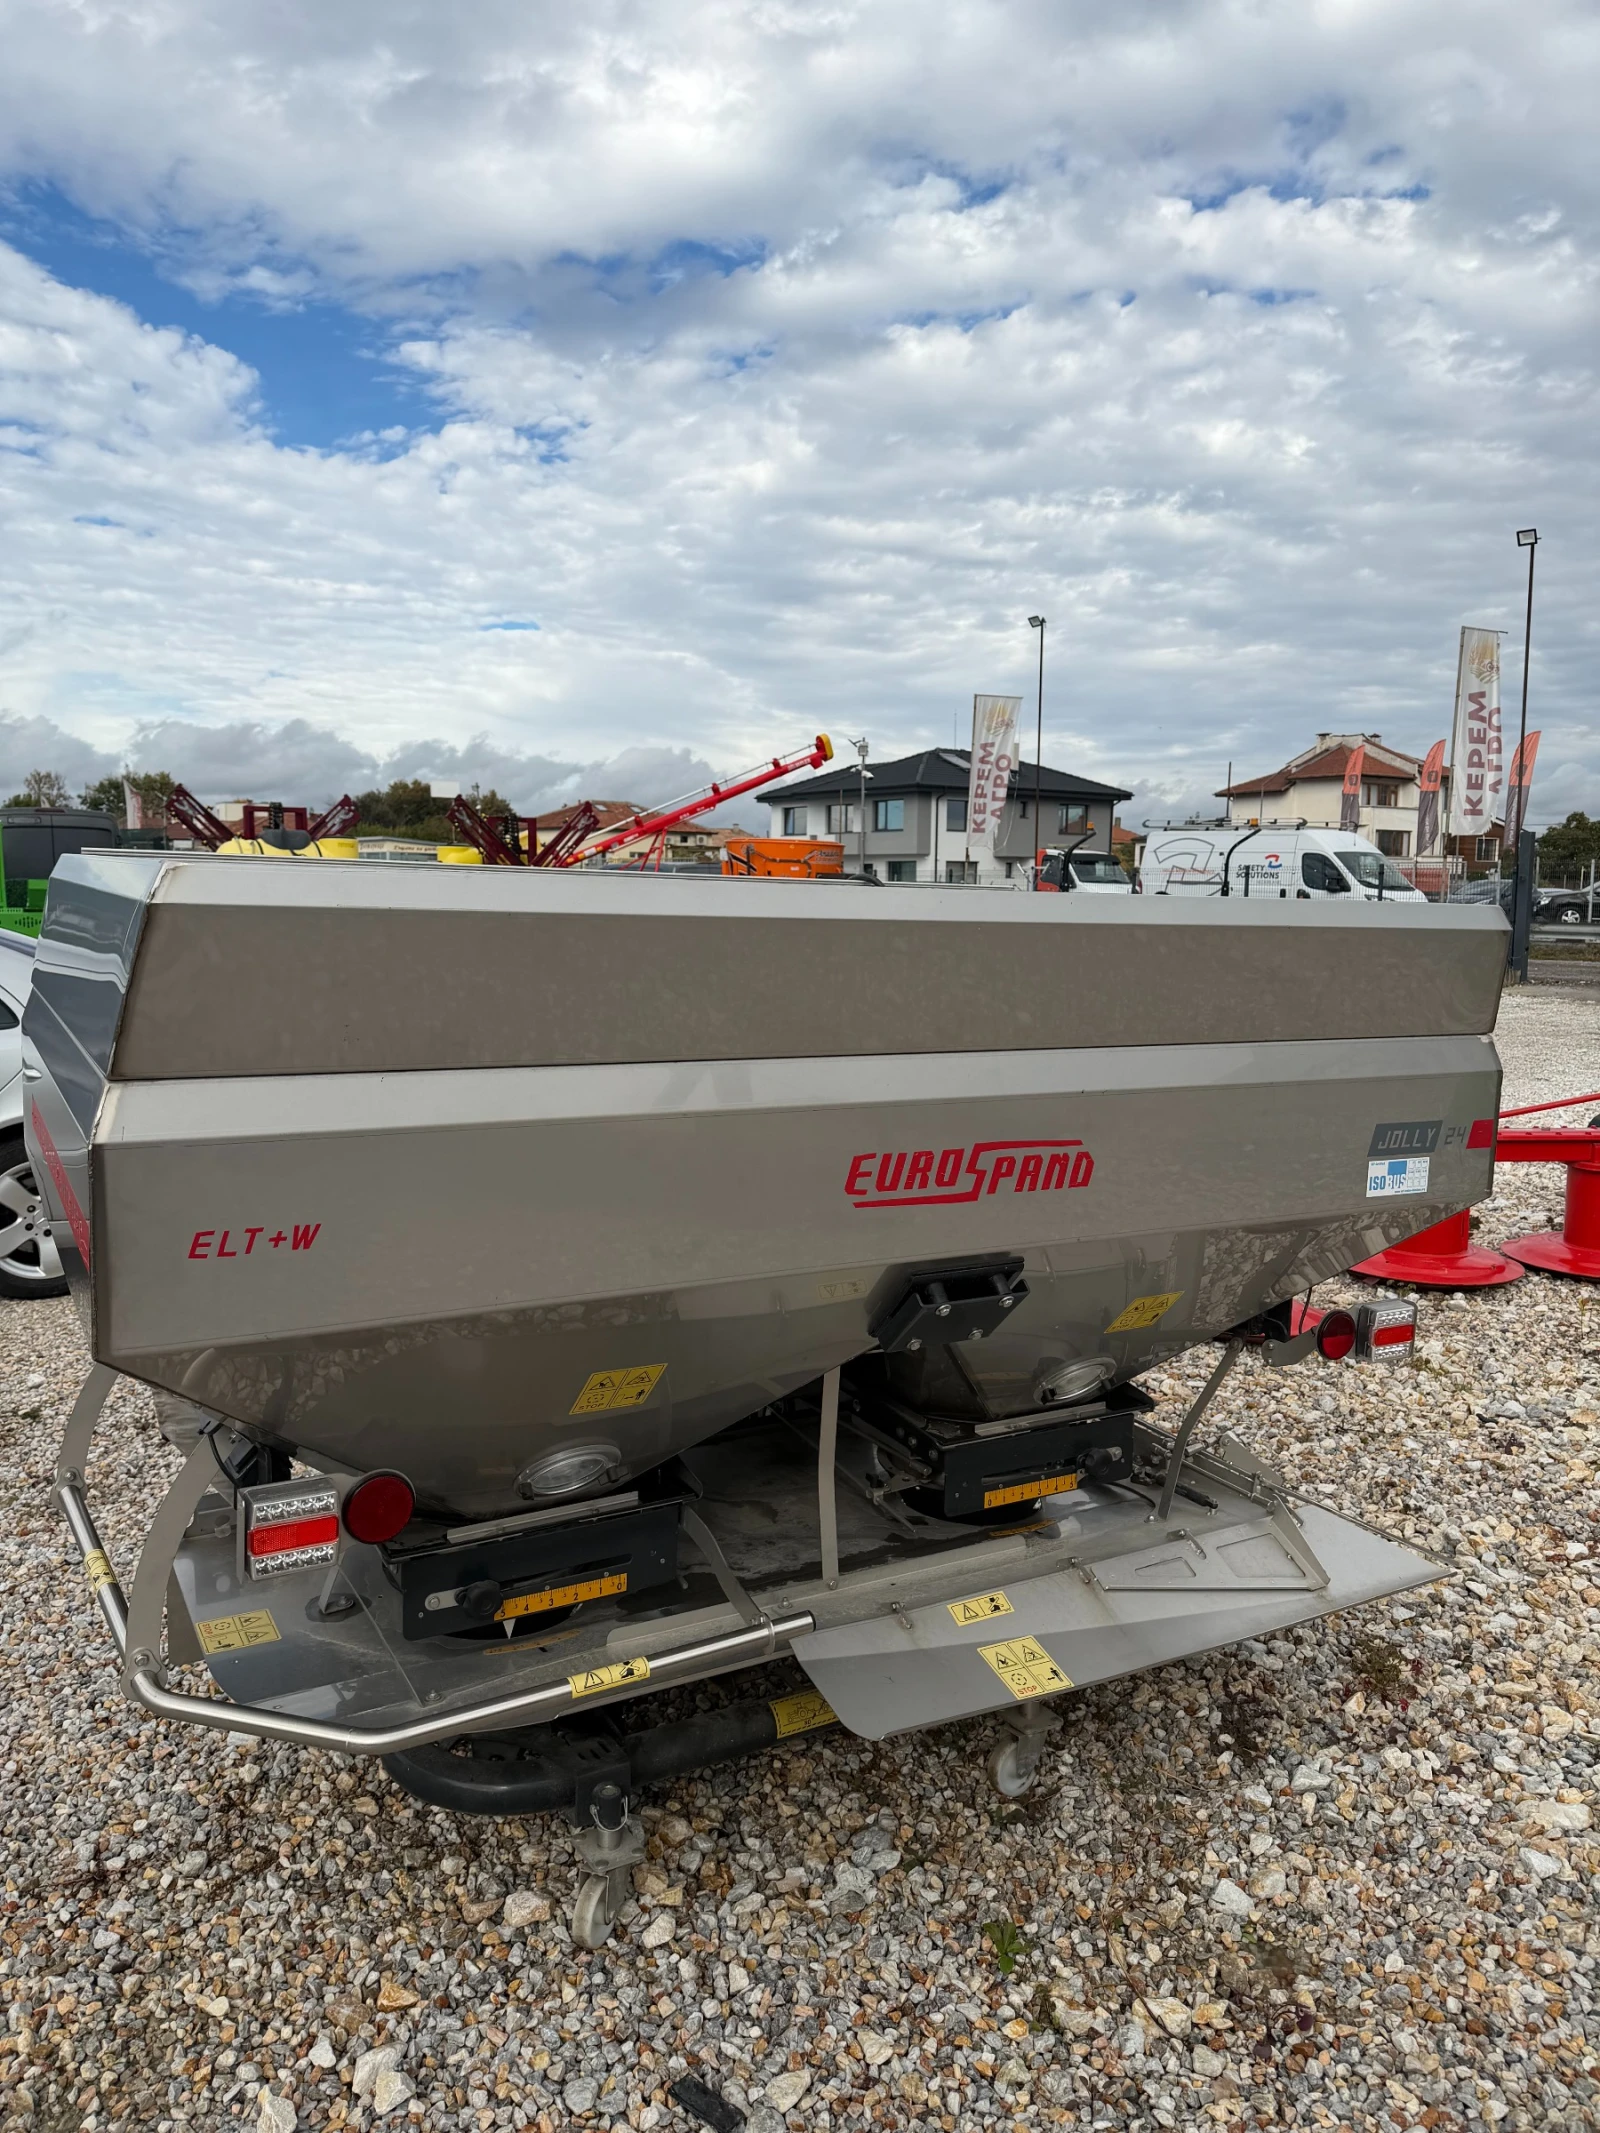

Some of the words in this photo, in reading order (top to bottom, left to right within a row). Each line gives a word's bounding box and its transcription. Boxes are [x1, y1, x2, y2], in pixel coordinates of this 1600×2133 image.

[1464, 690, 1487, 816] КЕРЕМ
[972, 741, 996, 833] КЕРЕМ
[1236, 871, 1280, 880] SOUTIONS
[1377, 1128, 1437, 1150] JOLLY
[1444, 1126, 1468, 1146] 24
[843, 1139, 1095, 1209] EUROSPAND
[1368, 1172, 1407, 1192] ISOBUS
[523, 1603, 529, 1612] 4
[548, 1598, 554, 1606] 3
[573, 1592, 579, 1601] 2
[616, 1582, 623, 1591] 0
[202, 1623, 214, 1635] STOP
[1017, 1685, 1038, 1695] STOP
